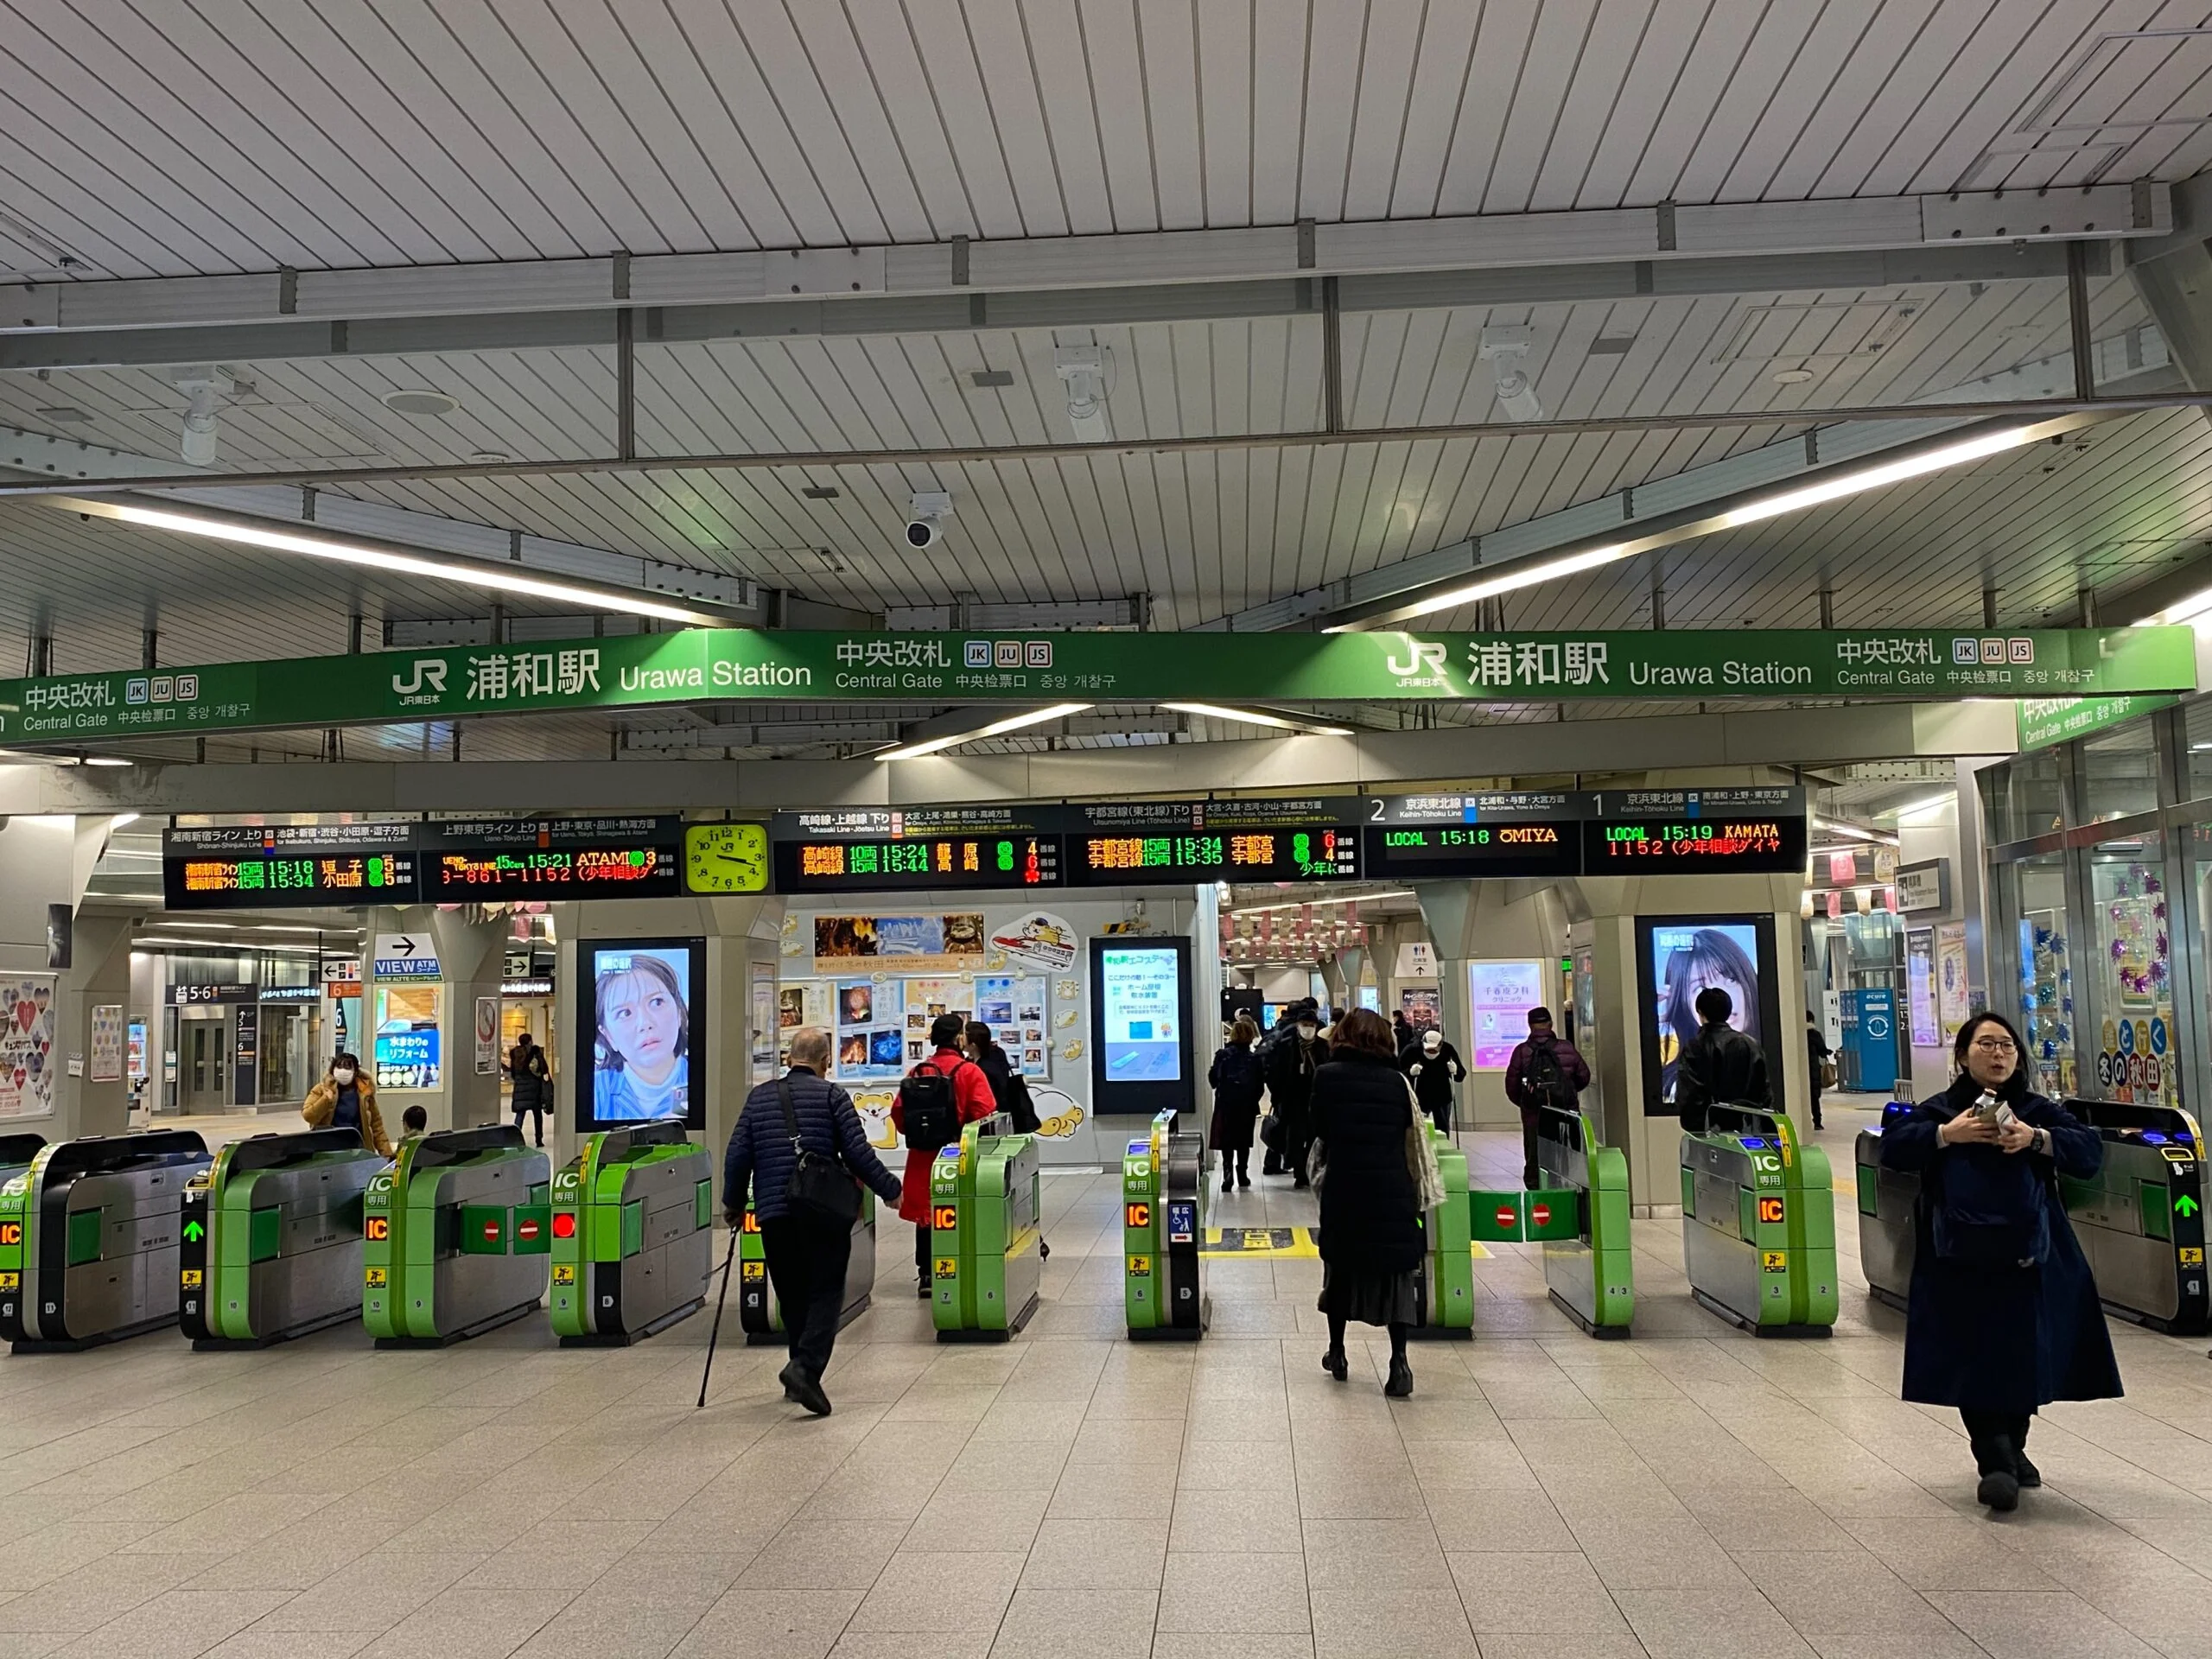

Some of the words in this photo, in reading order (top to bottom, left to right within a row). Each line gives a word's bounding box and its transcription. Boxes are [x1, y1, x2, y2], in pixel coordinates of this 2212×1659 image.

[836, 639, 951, 668] 中央改札
[969, 648, 987, 660] JK
[1000, 648, 1017, 660] JU
[1031, 648, 1046, 660] JS
[1387, 641, 1447, 677] JR
[1836, 638, 1942, 666] 中央改札
[1957, 645, 1973, 658] JK
[1985, 645, 2000, 658] JU
[2014, 645, 2027, 658] JS
[1467, 640, 1610, 686] 浦和駅
[391, 658, 448, 694] JR
[466, 649, 601, 701] 浦和駅
[619, 666, 703, 692] Urawa
[711, 660, 812, 687] Station
[836, 672, 897, 689] Central
[901, 673, 943, 689] Gate
[1039, 674, 1068, 689] 중앙
[1073, 673, 1117, 689] 개찰구
[1629, 662, 1714, 685] Urawa
[1722, 661, 1812, 685] Station
[1837, 670, 1892, 685] Central
[1897, 670, 1936, 685] Gate
[1946, 671, 2012, 684] 中央检票口
[2023, 670, 2049, 684] 중앙
[2055, 669, 2095, 684] 개찰구
[955, 674, 1027, 689] 中央检票口
[1395, 677, 1440, 688] JR東日本
[24, 680, 116, 712] 中央改札
[130, 685, 144, 697] JK
[155, 683, 168, 695] JU
[180, 683, 193, 694] JS
[398, 695, 441, 707] JR東日本
[118, 709, 176, 726] 中央检票口
[186, 706, 210, 721] 중앙
[214, 703, 251, 719] 개찰구
[23, 715, 72, 732] Central
[75, 713, 108, 728] Gate
[2025, 724, 2046, 745] Central
[2046, 721, 2062, 737] Gate
[1406, 798, 1462, 810] 京浜東北線
[1592, 794, 1602, 816] 1
[1627, 792, 1684, 804] 京浜東北線
[1170, 804, 1190, 816] 下り
[1370, 799, 1386, 821] 2
[1670, 804, 1685, 812] Line
[870, 812, 890, 824] 下り
[171, 830, 240, 842] 湘南新宿ライン
[244, 829, 263, 841] 上り
[442, 823, 514, 836] 上野東京ライン
[518, 822, 537, 833] 上り
[1606, 826, 1649, 842] LOCAL
[1662, 825, 1713, 841] 15:19
[1725, 824, 1779, 838] KAMATA
[710, 833, 720, 842] 11
[1088, 837, 1143, 854] 宇都宮線
[1142, 838, 1171, 853] 15両
[1176, 836, 1223, 852] 15:34
[1231, 836, 1274, 851] 宇都宮
[1325, 834, 1335, 848] 6
[1386, 832, 1428, 847] LOCAL
[1440, 830, 1490, 845] 15:18
[699, 842, 710, 850] 10
[721, 842, 734, 851] JR
[803, 845, 843, 861] 高崎線
[849, 845, 877, 860] 10両
[882, 844, 928, 859] 15:24
[1027, 841, 1038, 855] 4
[1610, 840, 1663, 855] 1152
[480, 862, 497, 871] LINE
[528, 854, 572, 868] 15:21
[576, 851, 630, 866] ATAMI
[645, 850, 657, 865] 3
[804, 860, 845, 875] 高崎線
[850, 859, 878, 874] 15両
[882, 858, 929, 873] 15:44
[1027, 855, 1038, 869] 6
[1088, 852, 1144, 868] 宇都宮線
[1142, 852, 1171, 866] 15両
[1176, 851, 1223, 866] 15:35
[1231, 850, 1274, 865] 宇都宮
[1325, 848, 1335, 861] 4
[237, 861, 264, 875] 15両
[269, 860, 314, 875] 15:18
[384, 858, 394, 872] 5
[238, 874, 264, 889] 15両
[269, 874, 315, 889] 15:34
[322, 873, 363, 888] 小田原
[385, 872, 395, 886] 5
[725, 878, 732, 887] 6
[737, 875, 745, 884] 5
[376, 961, 415, 973] VIEW
[333, 983, 342, 996] 6
[335, 1008, 342, 1027] 6
[238, 1042, 244, 1051] 6
[389, 1036, 429, 1047] 水まわりの
[390, 1048, 429, 1059] リフォーム
[1126, 1160, 1149, 1177] IC
[1754, 1155, 1781, 1172] IC
[555, 1173, 579, 1188] IC
[934, 1165, 957, 1180] IC
[1759, 1175, 1781, 1185] 専用
[368, 1176, 392, 1192] IC
[935, 1184, 955, 1193] 専用
[1128, 1180, 1147, 1191] 専用
[367, 1195, 387, 1205] 専用
[555, 1192, 574, 1202] 専用
[936, 1209, 956, 1228] IC
[1128, 1205, 1148, 1225] IC
[1761, 1200, 1783, 1221] IC
[2, 1224, 21, 1243] IC
[368, 1220, 387, 1238] IC
